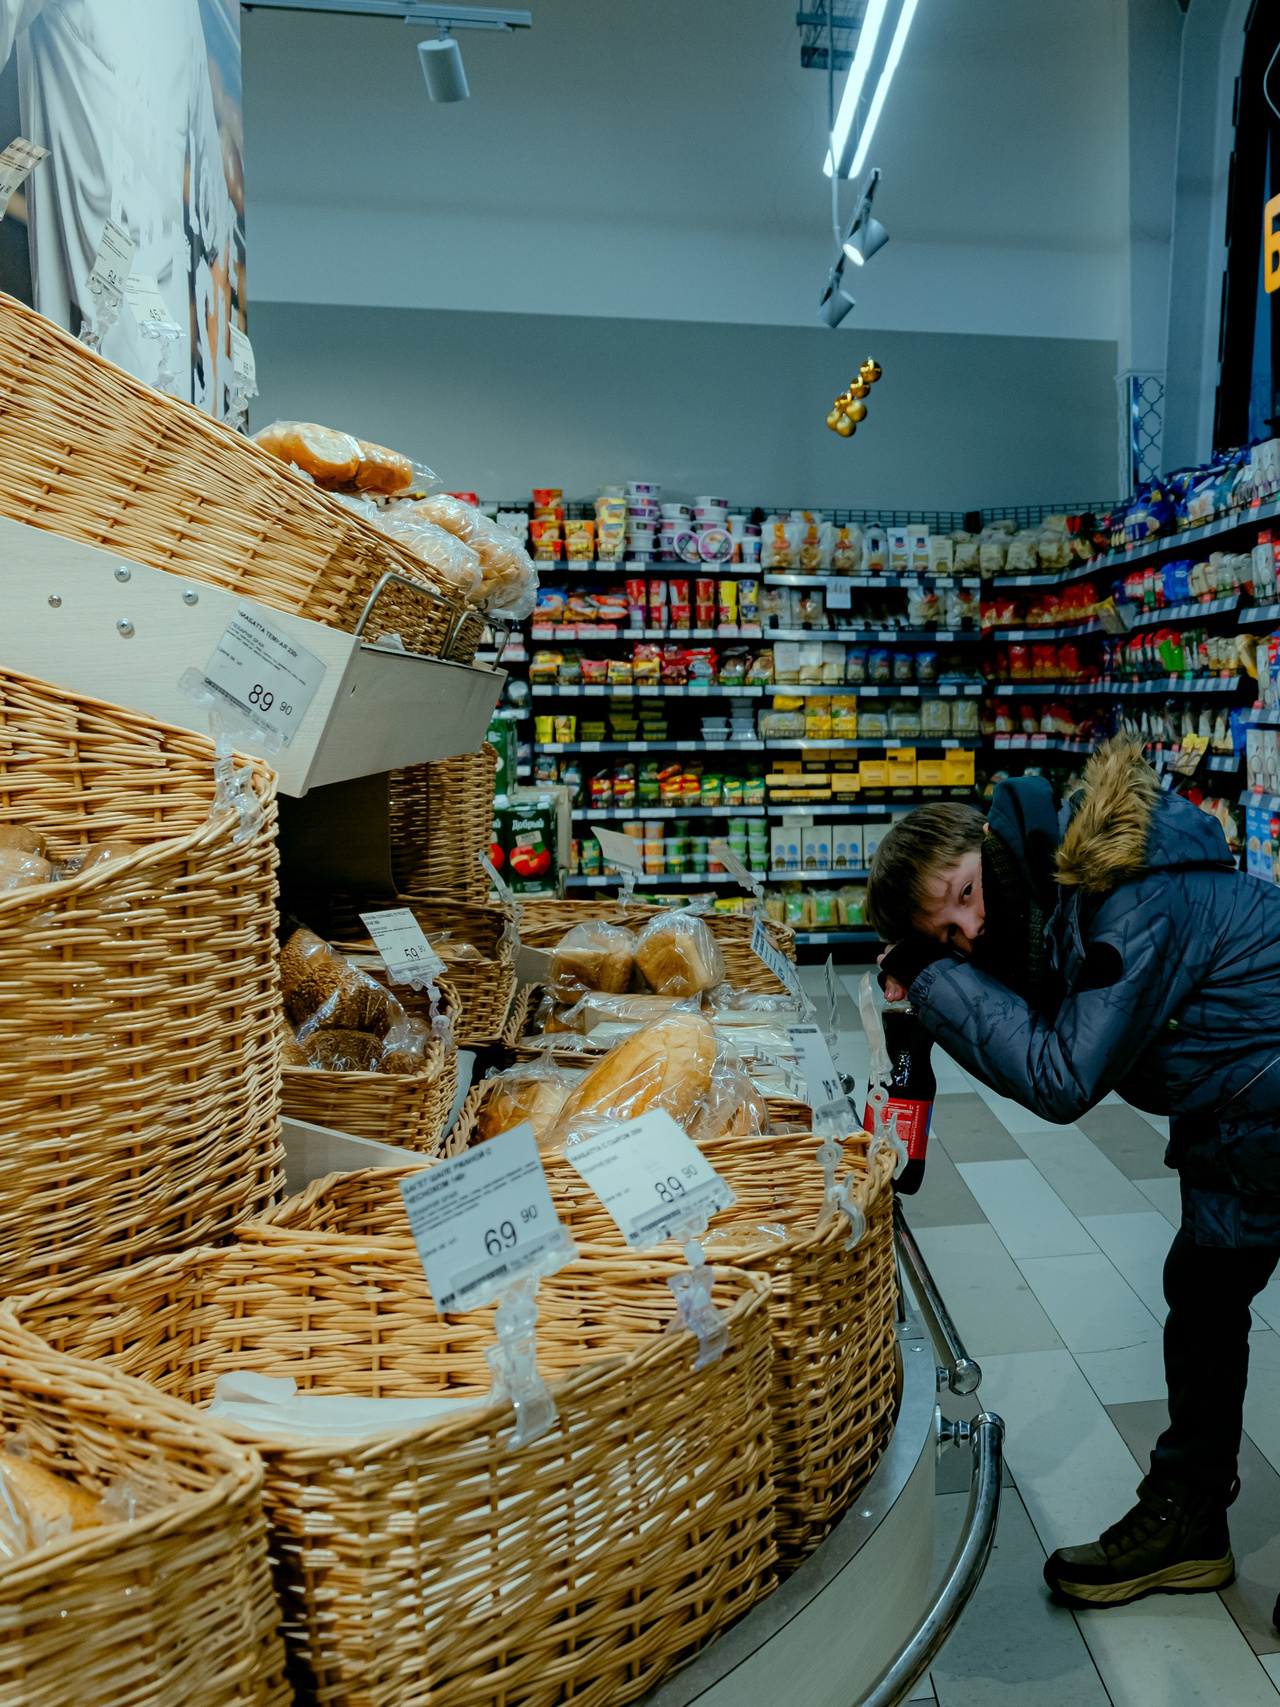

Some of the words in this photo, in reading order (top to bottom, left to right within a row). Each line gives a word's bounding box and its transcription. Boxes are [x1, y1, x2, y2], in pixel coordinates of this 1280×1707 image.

[148, 307, 162, 322] 45
[266, 630, 288, 650] ТЕМНАЯ
[248, 683, 274, 712] 89
[279, 701, 293, 716] 90
[512, 818, 545, 831] Добрый
[404, 947, 419, 960] 59
[655, 1176, 686, 1204] 89
[681, 1164, 698, 1179] 90
[484, 1220, 518, 1258] 69
[520, 1204, 538, 1224] 90
